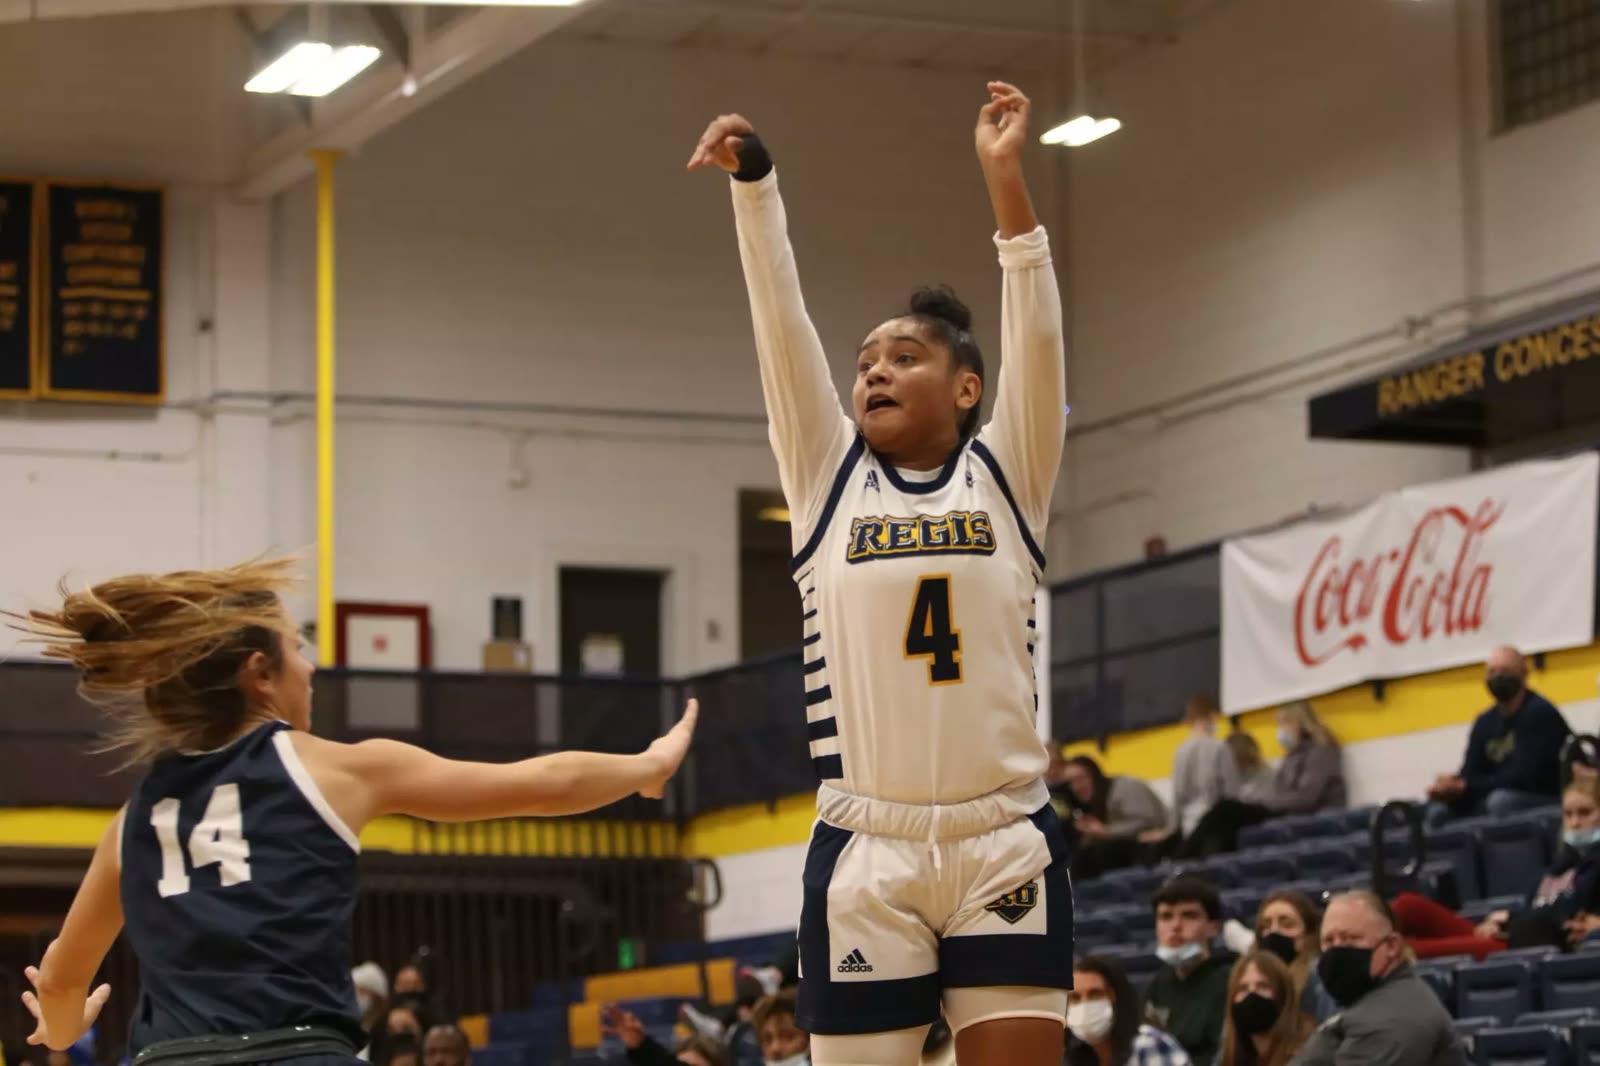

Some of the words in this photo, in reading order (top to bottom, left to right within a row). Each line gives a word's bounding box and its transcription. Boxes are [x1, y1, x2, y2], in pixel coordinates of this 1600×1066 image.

[1377, 352, 1485, 416] RANGER
[847, 511, 997, 564] REGIS
[904, 573, 964, 687] 4
[151, 783, 251, 898] 14
[837, 963, 873, 973] adidas
